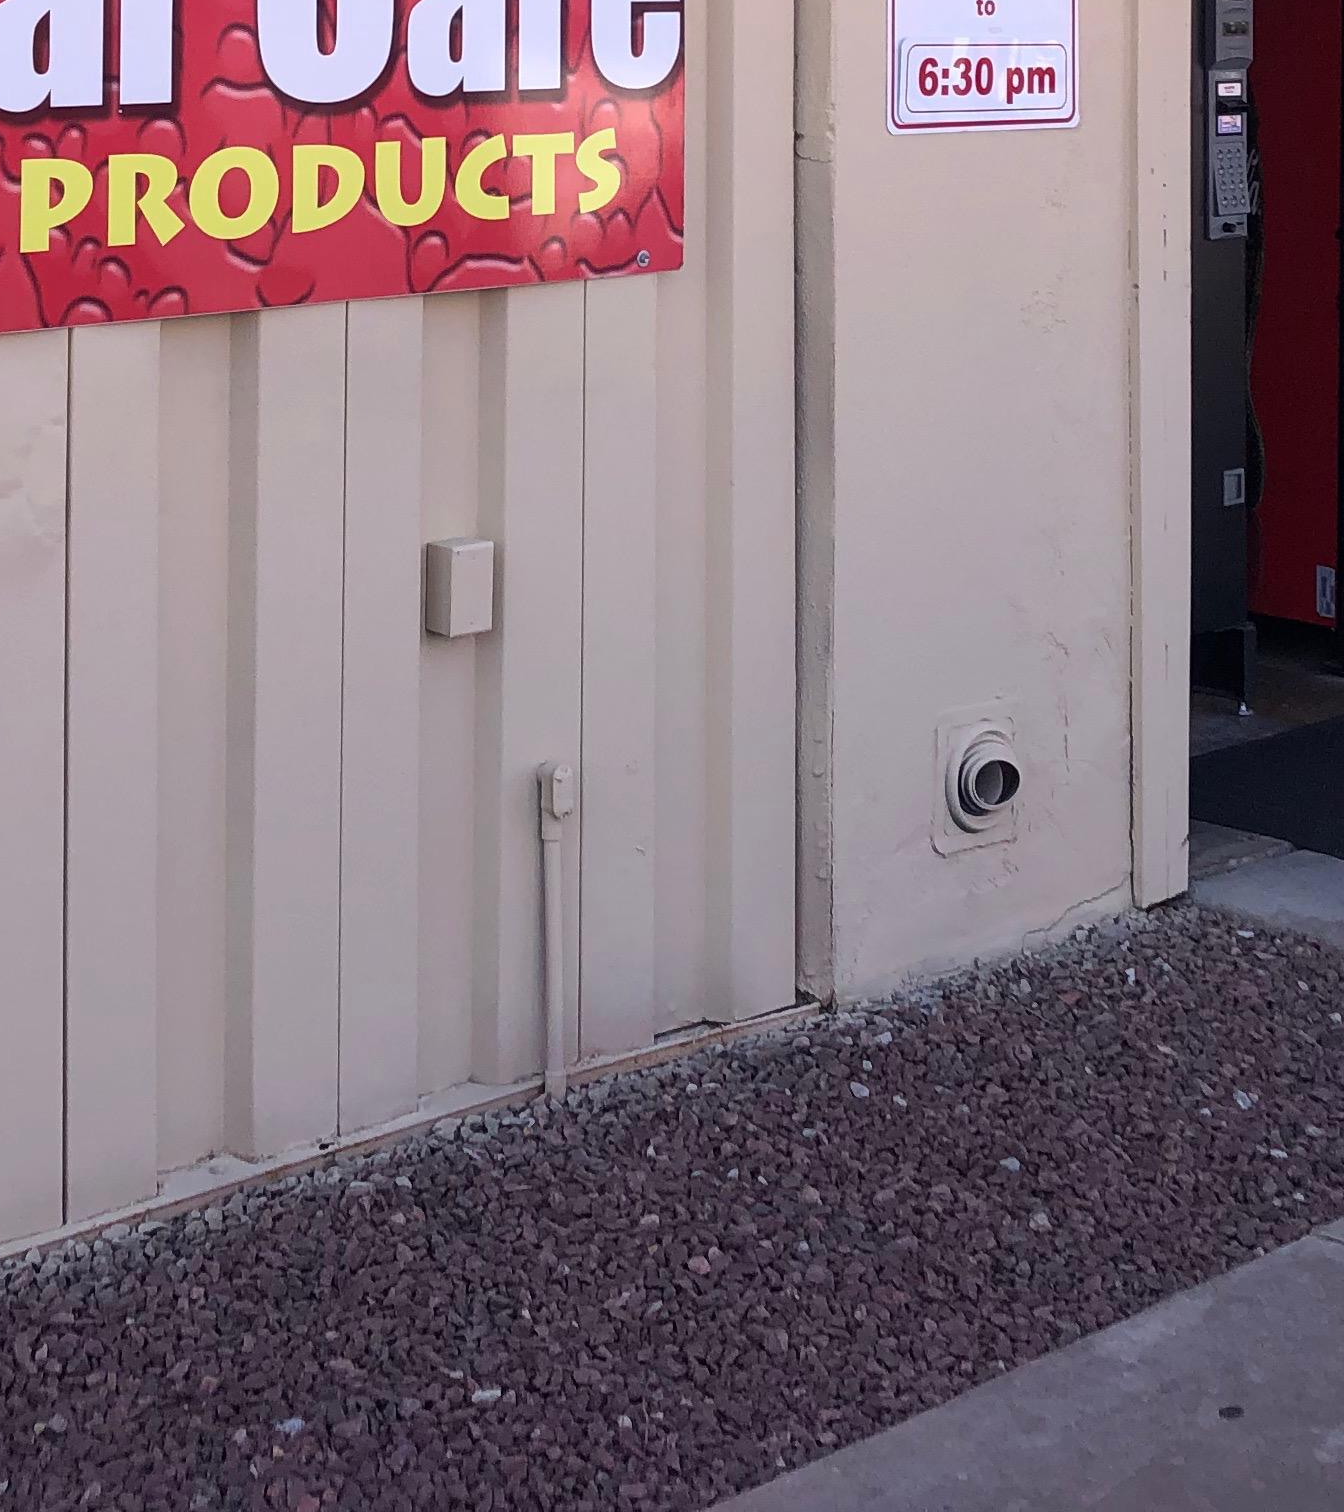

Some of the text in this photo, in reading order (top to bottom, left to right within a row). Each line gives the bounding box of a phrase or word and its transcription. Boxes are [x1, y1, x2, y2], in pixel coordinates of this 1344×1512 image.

[918, 57, 1057, 104] 6:30 pm
[20, 128, 622, 253] PRODUCTS
